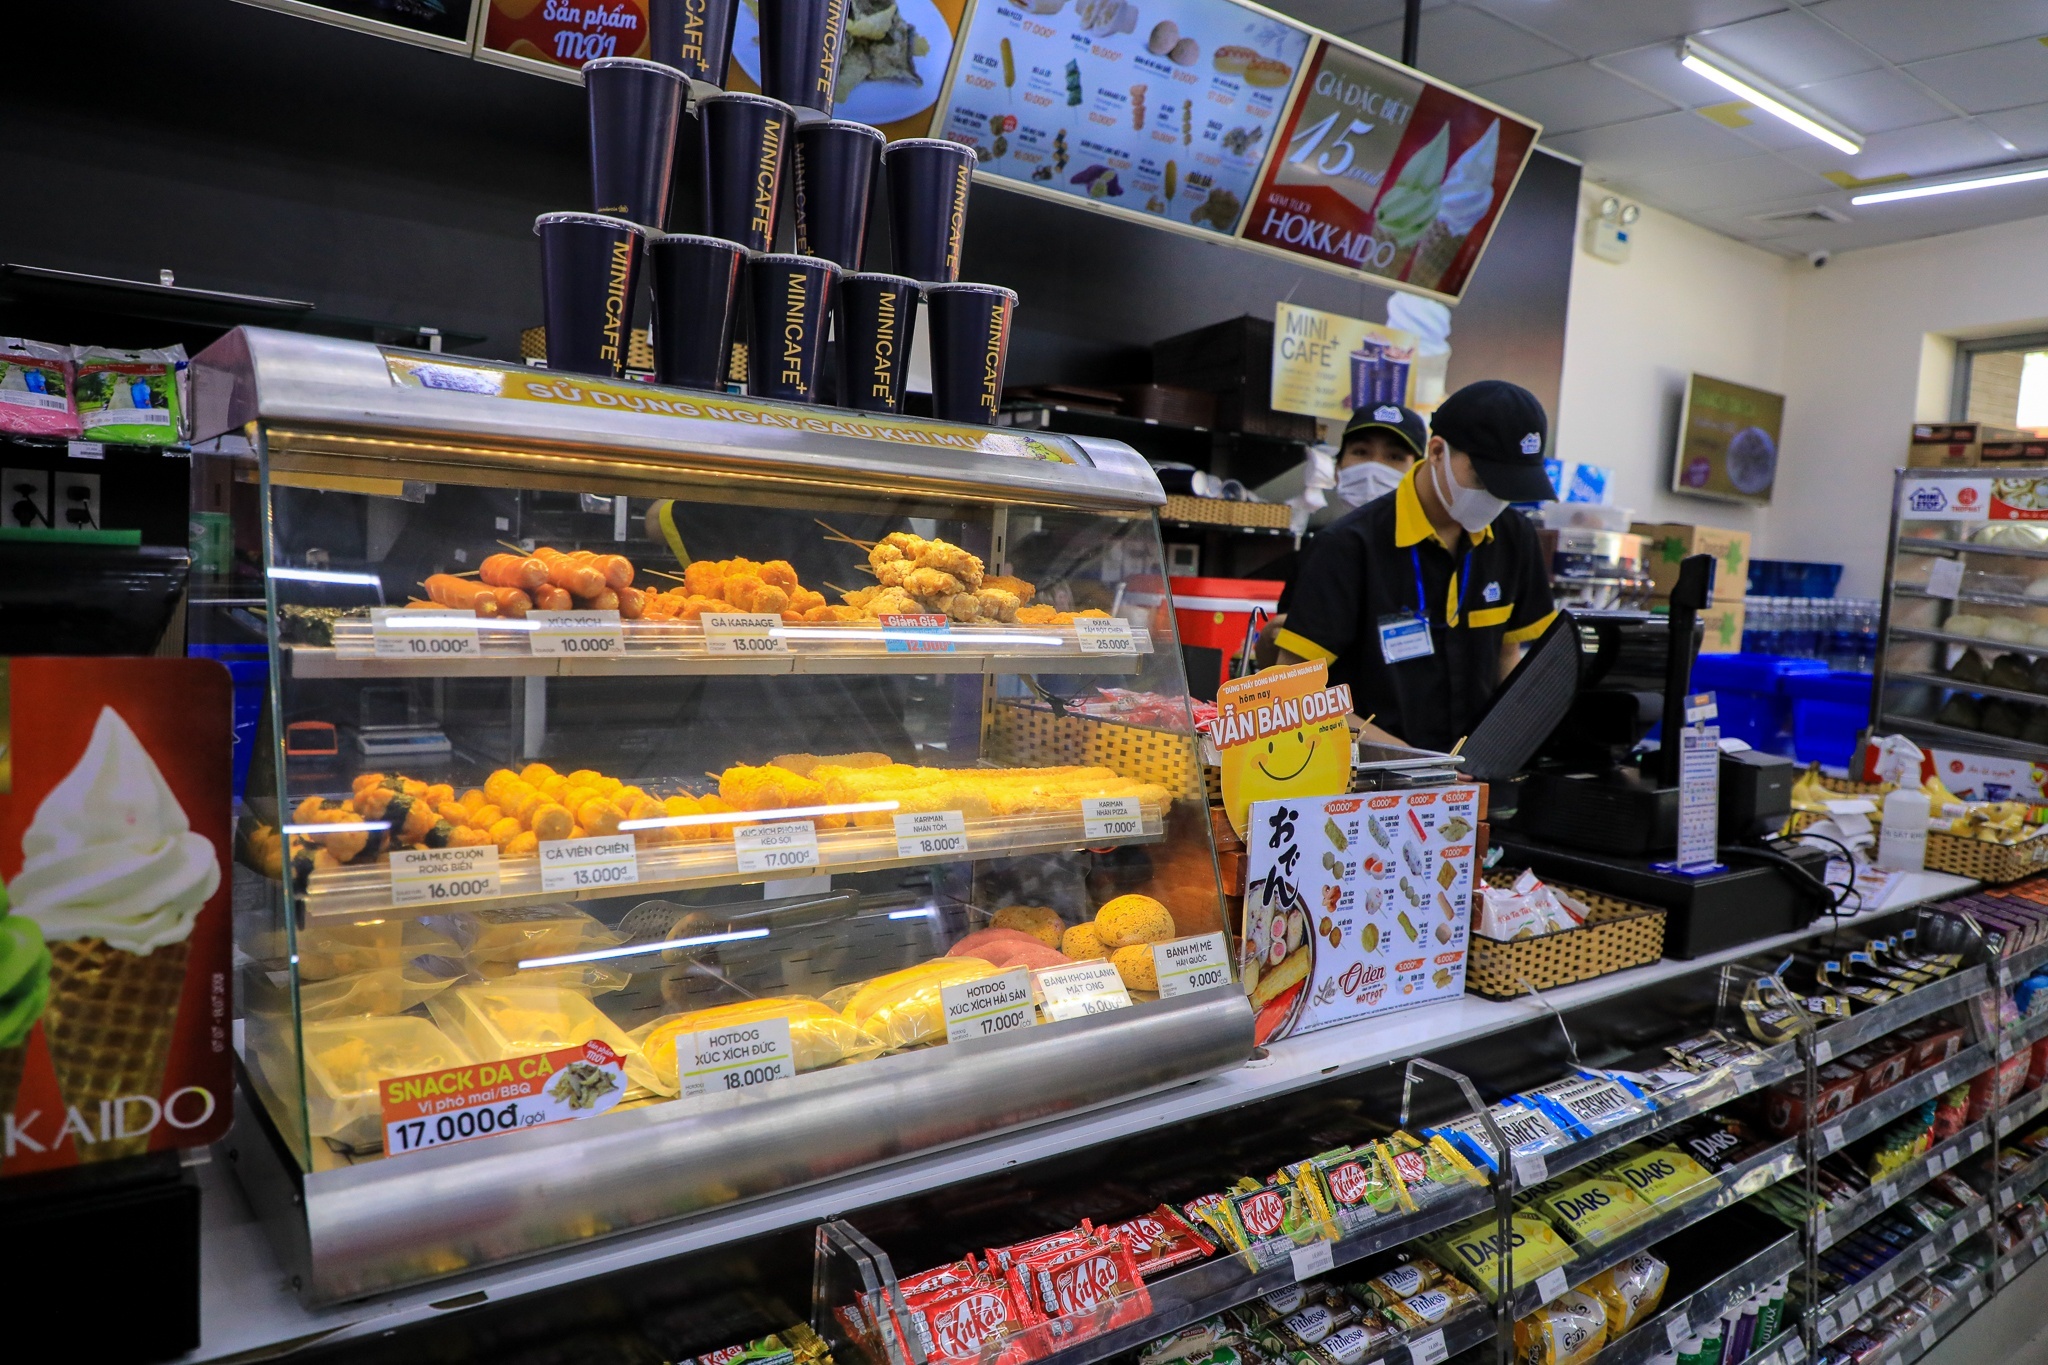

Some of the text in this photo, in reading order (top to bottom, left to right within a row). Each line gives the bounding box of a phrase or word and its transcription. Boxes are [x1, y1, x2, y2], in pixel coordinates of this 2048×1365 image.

[543, 0, 637, 30] Sản phẩm
[817, 0, 844, 105] INICAFE+
[1261, 208, 1396, 268] HOKKAIDO
[600, 241, 630, 373] MINICAFE+
[782, 273, 808, 395] MINICAFE+
[1286, 311, 1329, 341] MINI
[872, 291, 896, 407] MINICAFE+
[527, 381, 583, 402] SỬ
[590, 391, 701, 417] DỤNG
[706, 405, 801, 430] NGAY
[804, 417, 877, 438] SAU
[875, 426, 932, 445] KHI
[548, 616, 602, 628] XÚC XÍCH
[711, 617, 775, 627] GÀ KARAAGE
[888, 615, 938, 627] Giảm Giá
[1239, 689, 1271, 704] hôm nay
[1210, 685, 1350, 746] VẪN BÁN ODEN
[566, 845, 592, 858] VIÊN
[595, 842, 629, 856] CHIÊN
[1263, 806, 1300, 908] おでん
[419, 863, 449, 873] RONG
[1166, 945, 1189, 958] BÁNH
[967, 981, 1006, 998] HOTDOG
[1043, 969, 1116, 988] BÁNH KHOAI LANG
[1085, 981, 1105, 992] ONG
[1339, 962, 1386, 995] Oden
[949, 989, 1027, 1016] XÚC XÍCH HẢI SẢN
[981, 1010, 1024, 1034] 17.000đ
[709, 1029, 760, 1048] HOTDOG
[695, 1041, 777, 1066] XÚC XÍCH ĐỨC
[388, 1052, 554, 1104] SNACK DA CÁ
[723, 1064, 781, 1090] 18.000đ
[418, 1100, 434, 1114] Vị
[436, 1094, 465, 1113] phô
[3, 1086, 215, 1157] KAIDO
[1689, 1129, 1738, 1159] DARS
[1623, 1158, 1676, 1188] DARS
[1250, 1194, 1282, 1232] KitKat
[1554, 1188, 1611, 1222] DARS
[1456, 1229, 1526, 1268] DAS
[1067, 1257, 1116, 1315] KitKat
[1382, 1267, 1418, 1288] Fitness
[1408, 1293, 1446, 1313] Fitness
[946, 1296, 1003, 1356] KitKat
[1287, 1308, 1328, 1333] Fitnesse
[1323, 1328, 1364, 1353] Fitnesse
